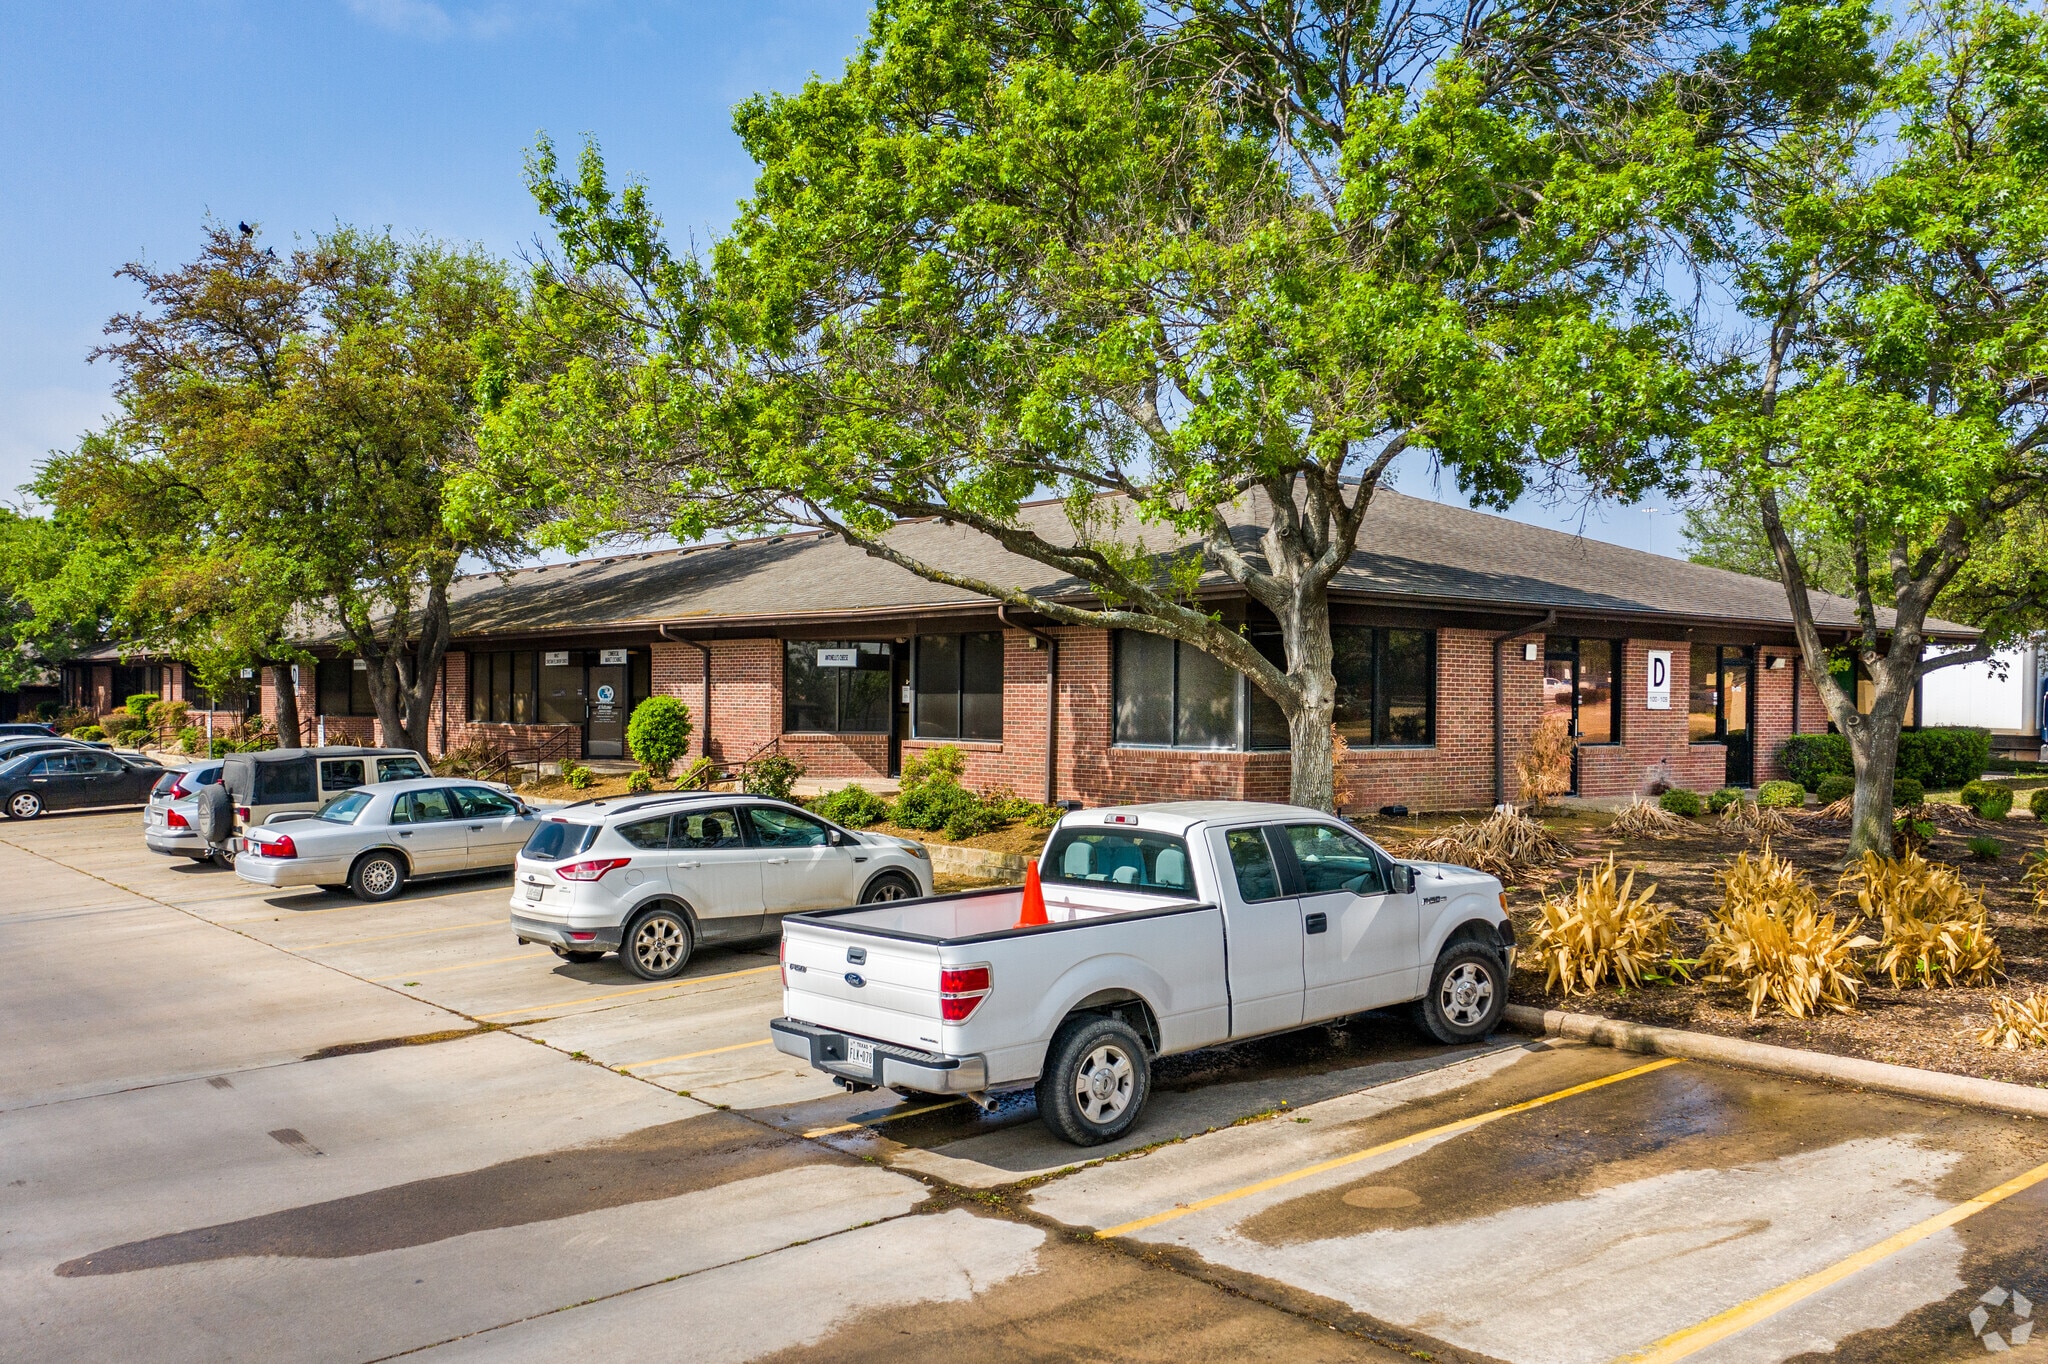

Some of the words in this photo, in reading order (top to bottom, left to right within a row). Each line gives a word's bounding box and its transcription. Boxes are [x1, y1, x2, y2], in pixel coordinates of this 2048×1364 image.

[1654, 657, 1665, 687] D
[856, 1041, 869, 1050] TEXAS
[849, 1047, 873, 1064] FLK-078
